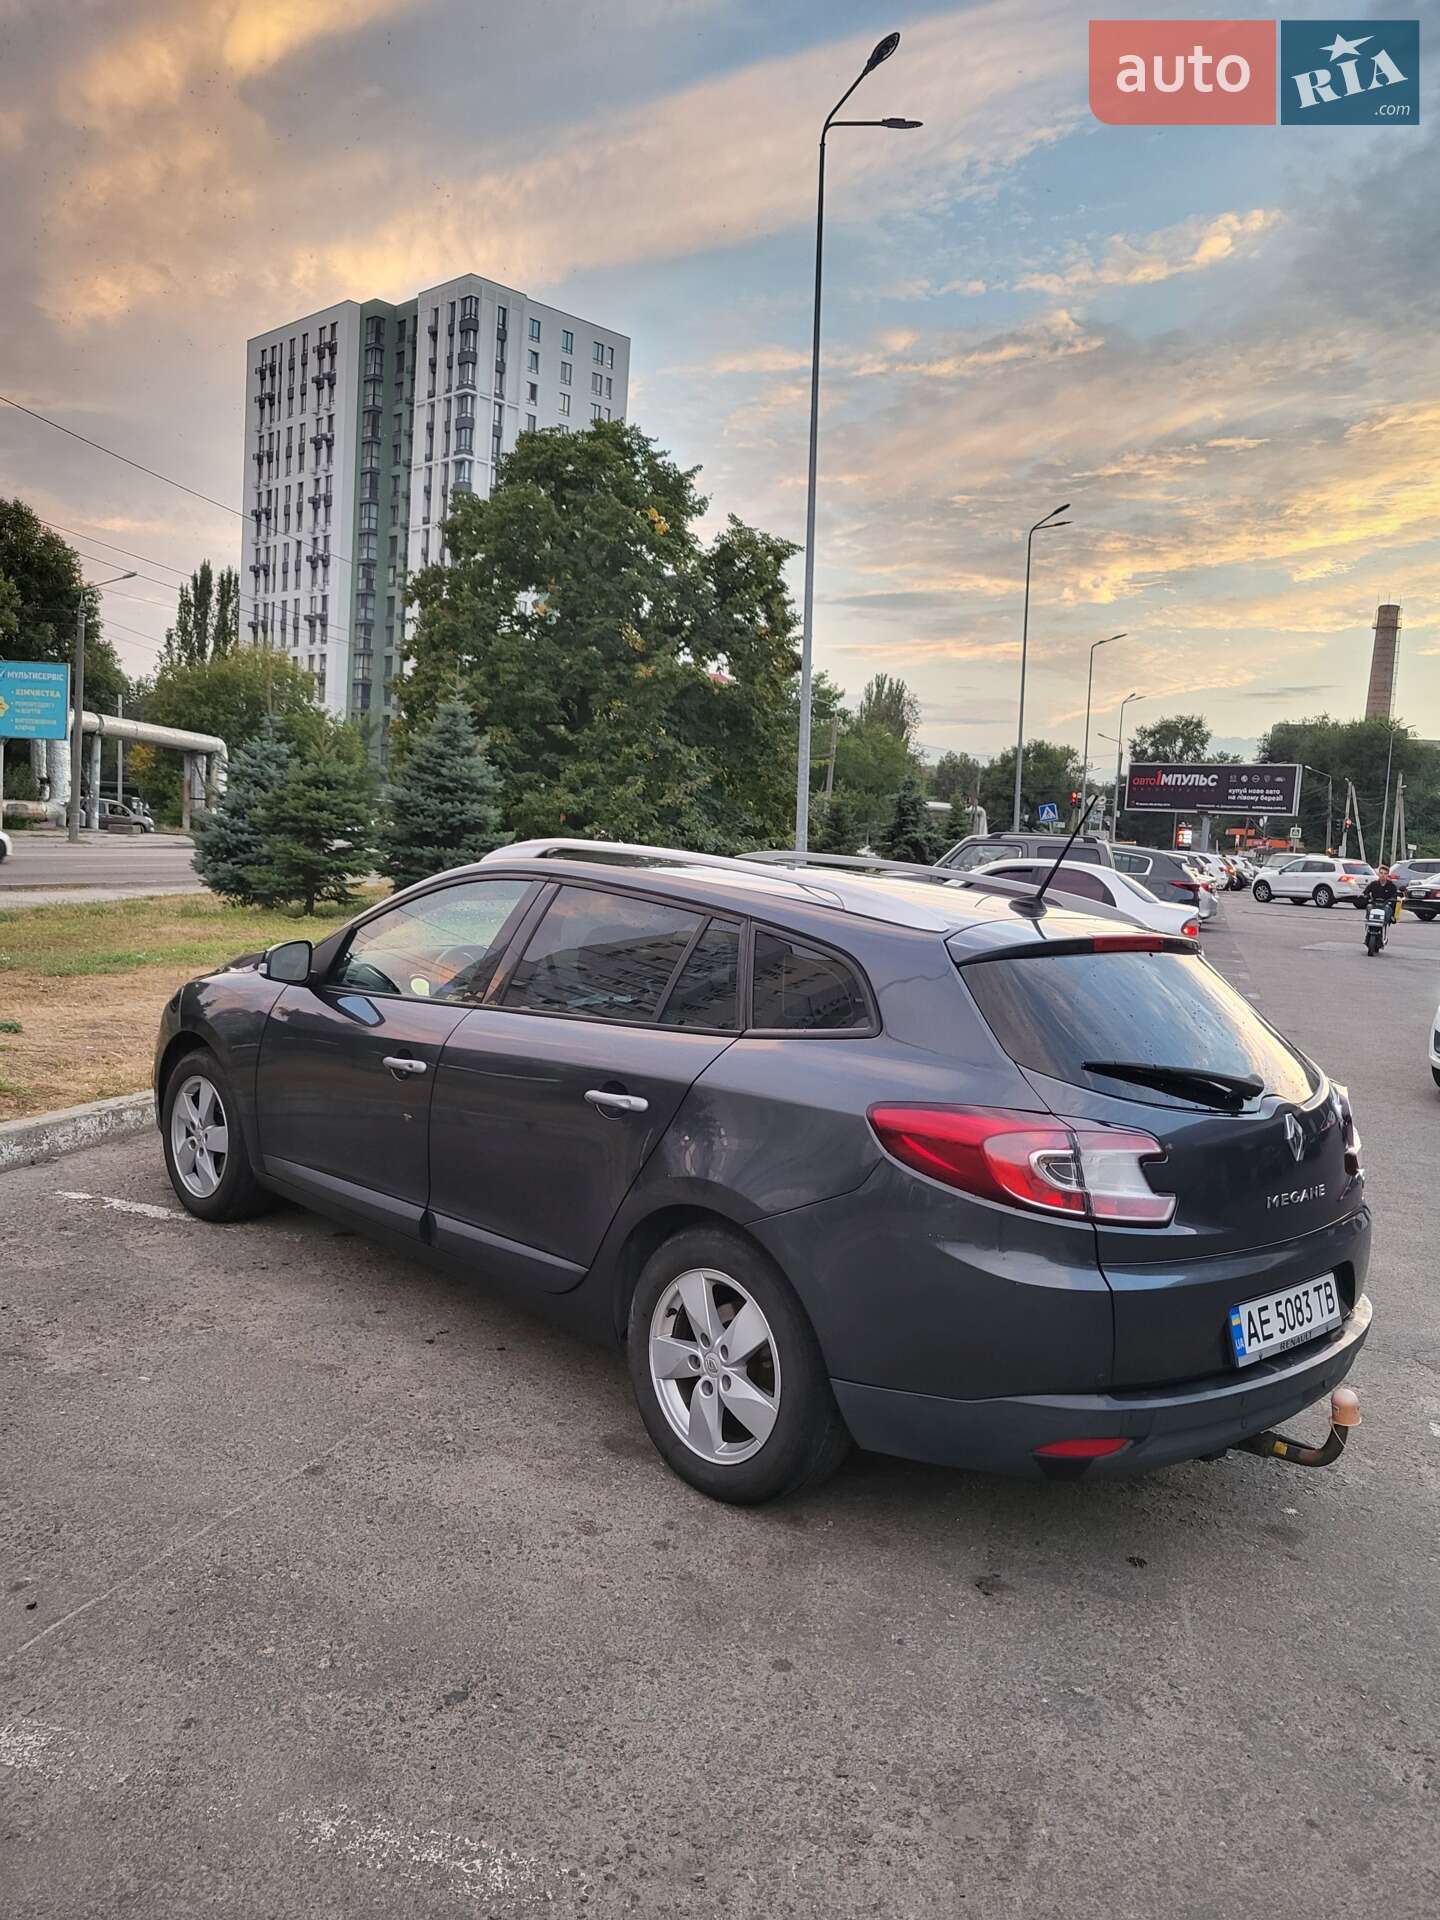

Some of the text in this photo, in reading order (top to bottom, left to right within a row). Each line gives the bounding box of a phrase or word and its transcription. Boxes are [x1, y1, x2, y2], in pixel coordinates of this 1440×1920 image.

[7, 671, 65, 681] МУЛЬТИСЕРВІС
[1265, 1183, 1326, 1209] MEGANE
[1247, 1280, 1336, 1348] AE 5083 TB
[1235, 1339, 1246, 1351] UA
[1279, 1330, 1313, 1351] RENAULT
